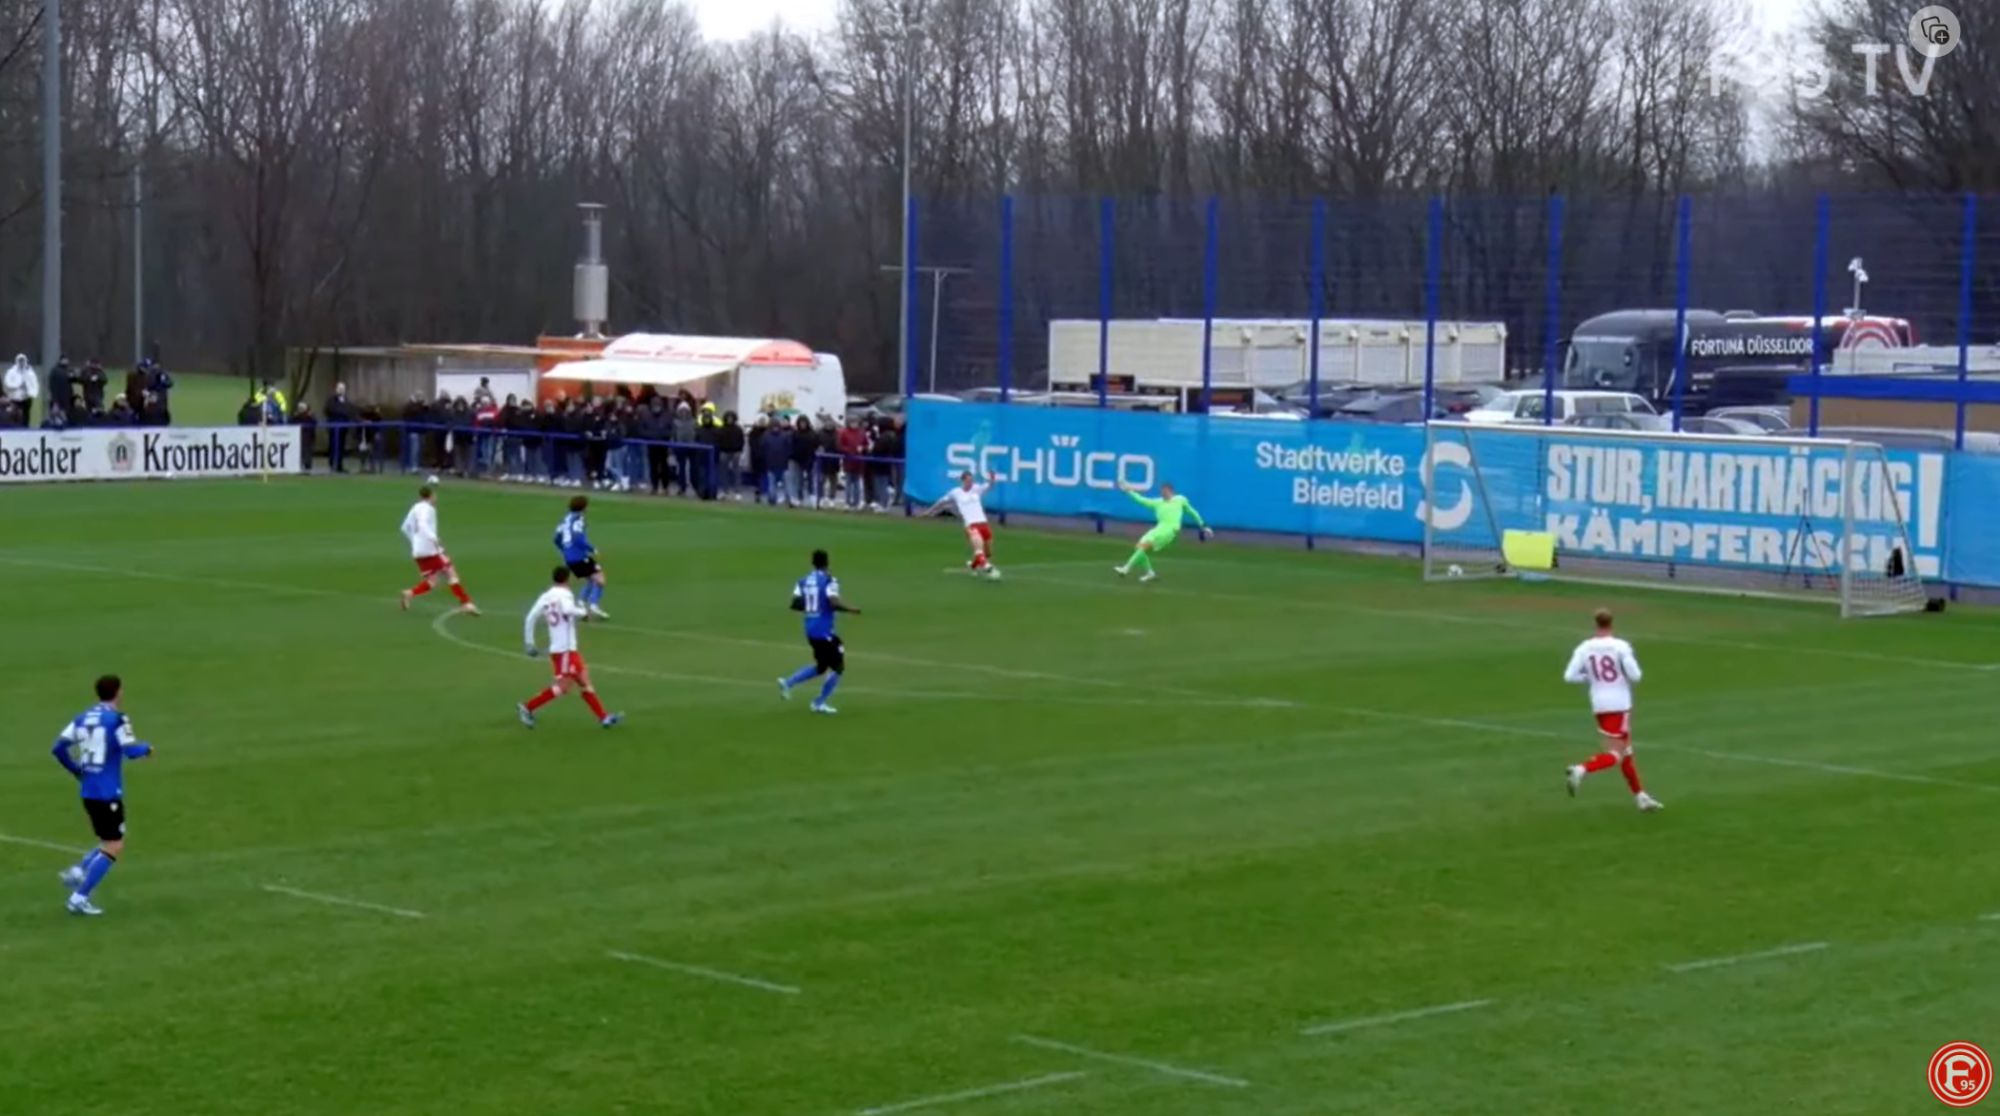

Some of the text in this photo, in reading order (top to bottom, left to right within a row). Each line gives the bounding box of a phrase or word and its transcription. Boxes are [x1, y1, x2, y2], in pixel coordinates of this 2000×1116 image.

[1691, 335, 1814, 356] FORTUNA DÜSSELDOR
[0, 431, 290, 476] bacher Krombacher
[946, 434, 1155, 492] SCHÜCO
[1256, 441, 1405, 476] Stadtwerke
[1292, 476, 1404, 511] Bielefeld
[1547, 443, 1653, 513] STUR,
[1588, 654, 1619, 684] 18
